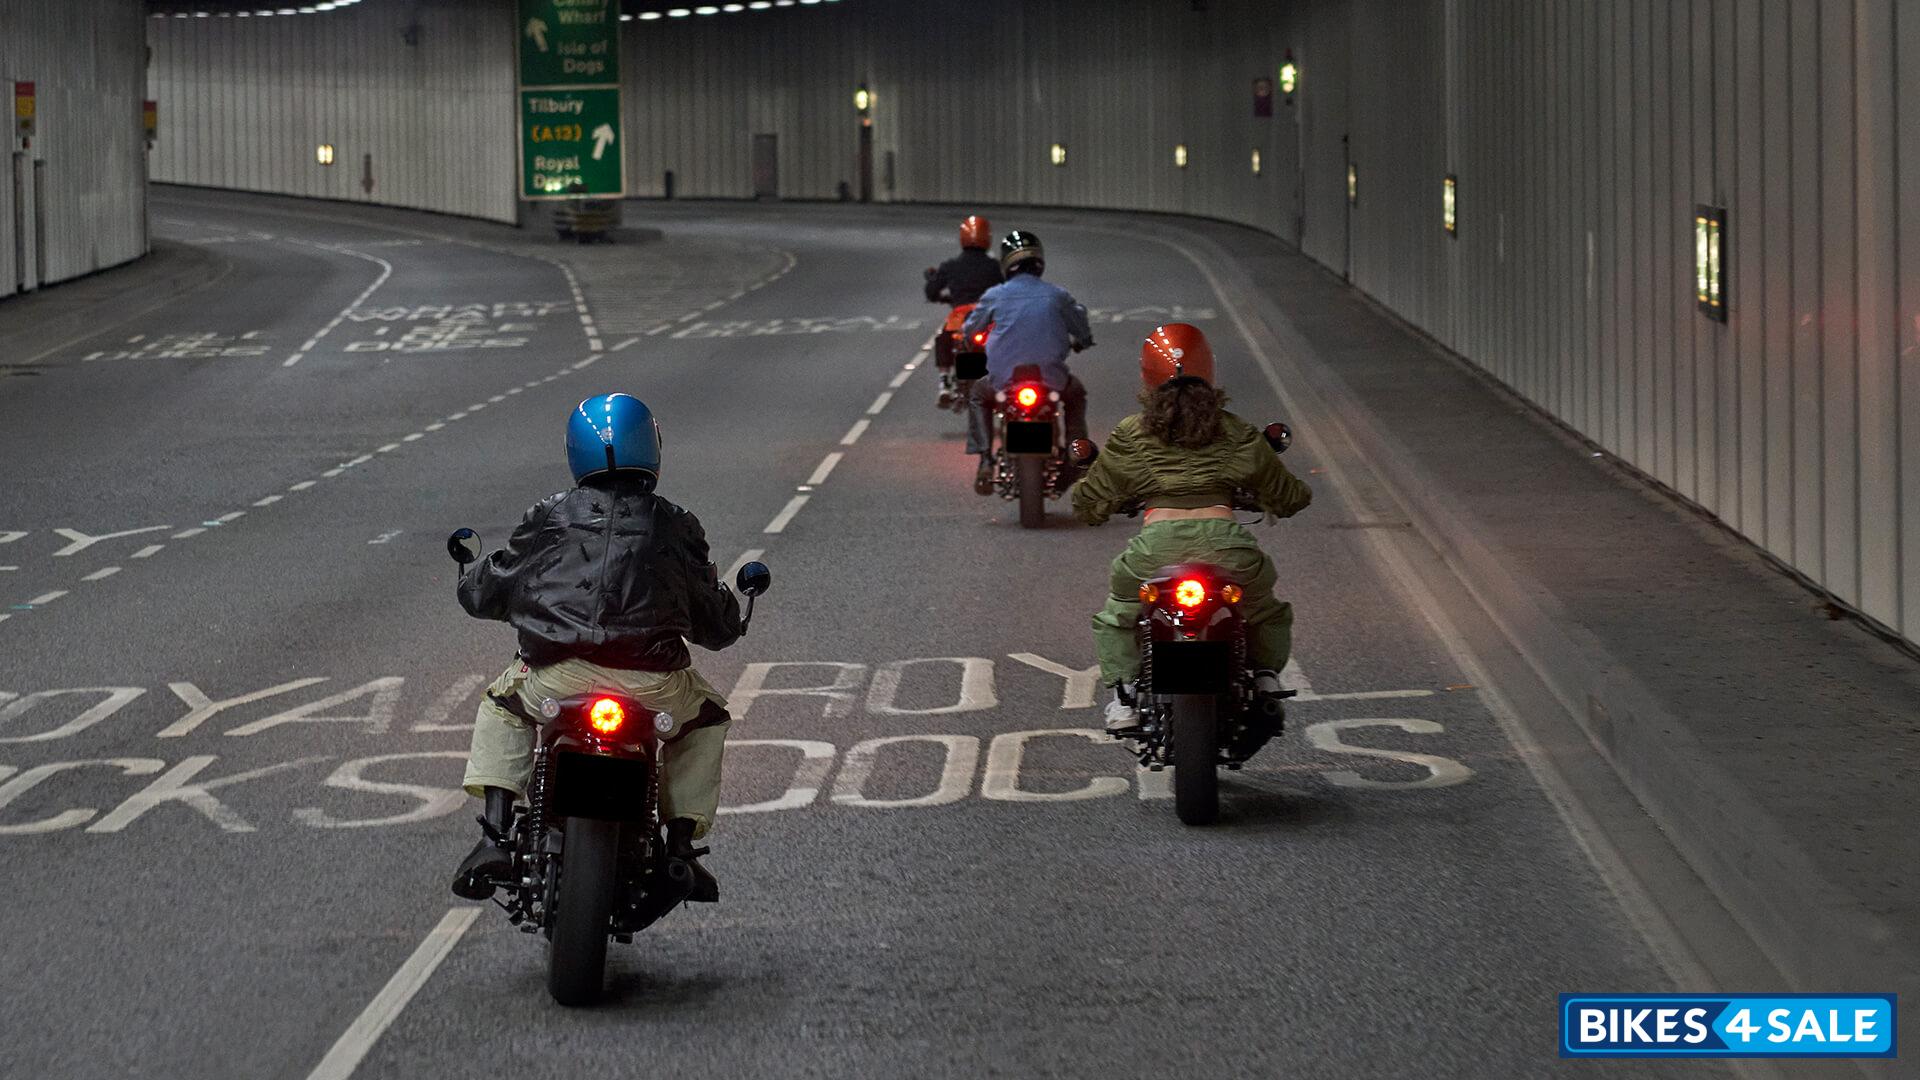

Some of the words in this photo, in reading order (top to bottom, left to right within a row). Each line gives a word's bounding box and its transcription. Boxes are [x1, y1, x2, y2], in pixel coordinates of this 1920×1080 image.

[529, 97, 584, 115] Tilbury
[531, 124, 582, 143] (A13)
[534, 155, 580, 173] Royal
[716, 717, 1476, 815] DOCS
